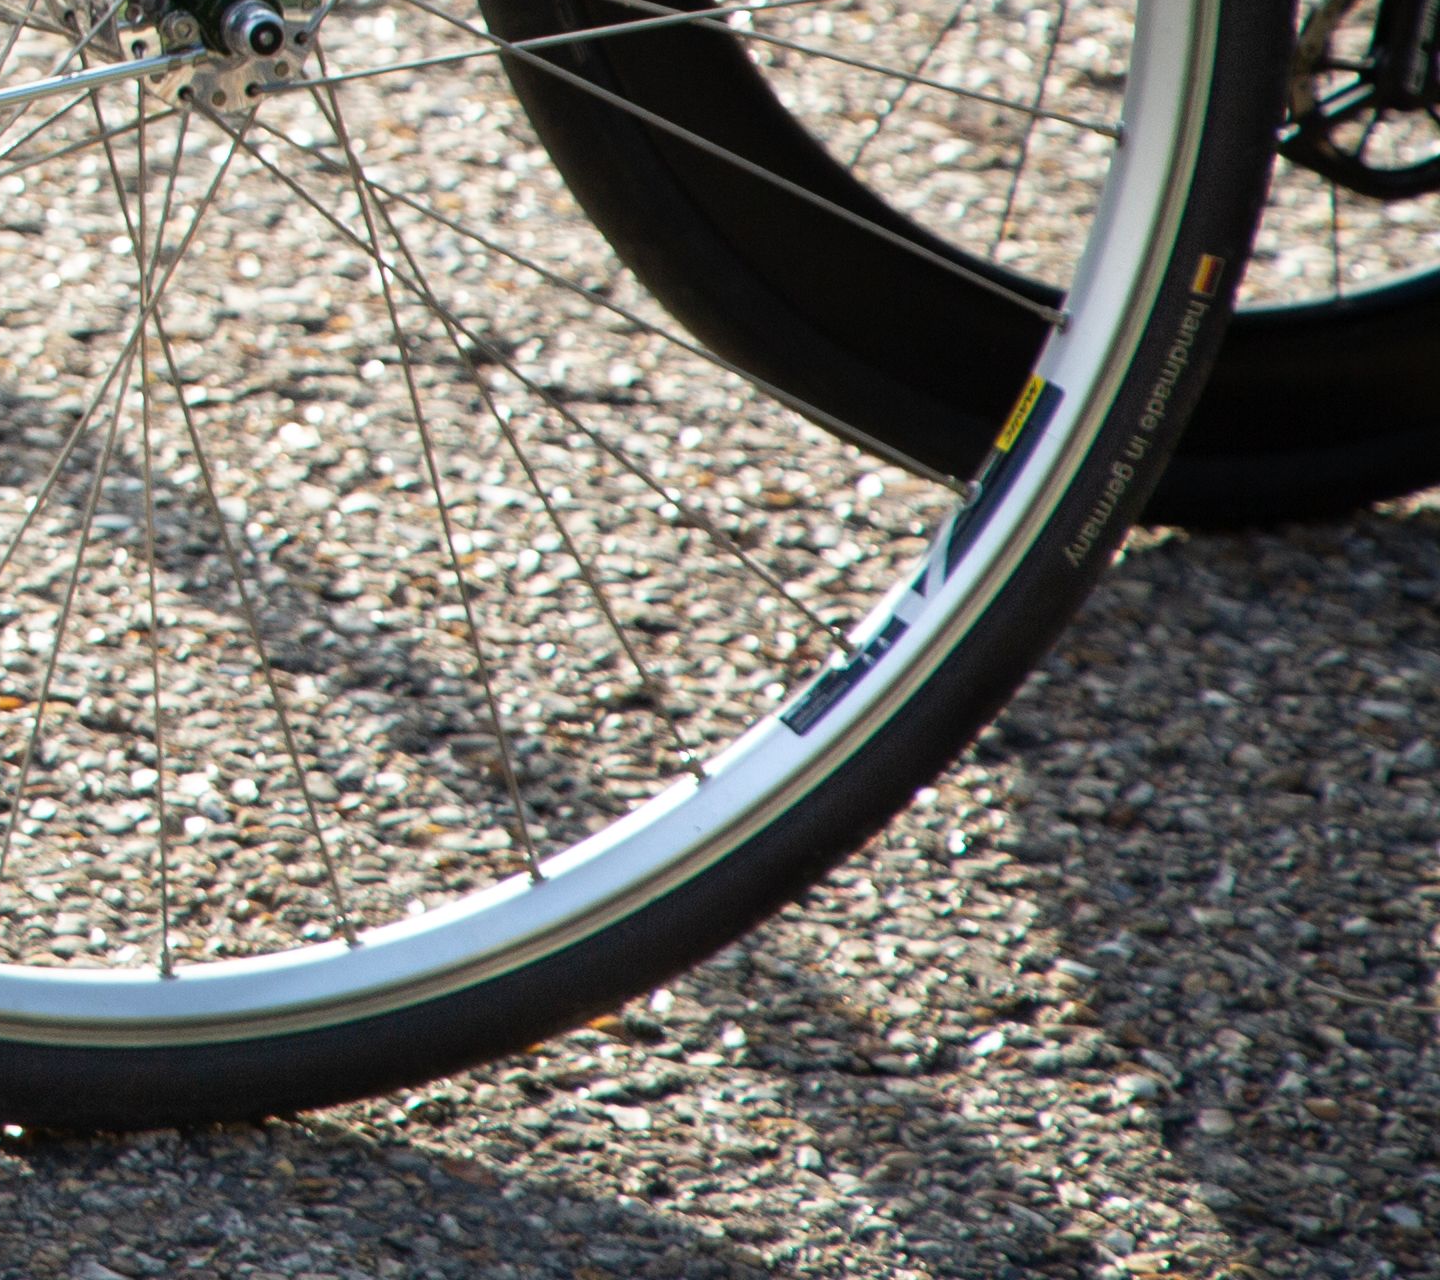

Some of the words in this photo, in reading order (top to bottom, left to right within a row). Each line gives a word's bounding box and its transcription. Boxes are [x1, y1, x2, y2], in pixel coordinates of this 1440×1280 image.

[1140, 296, 1210, 432] handmade
[1129, 436, 1153, 466] in
[1065, 461, 1137, 567] germany
